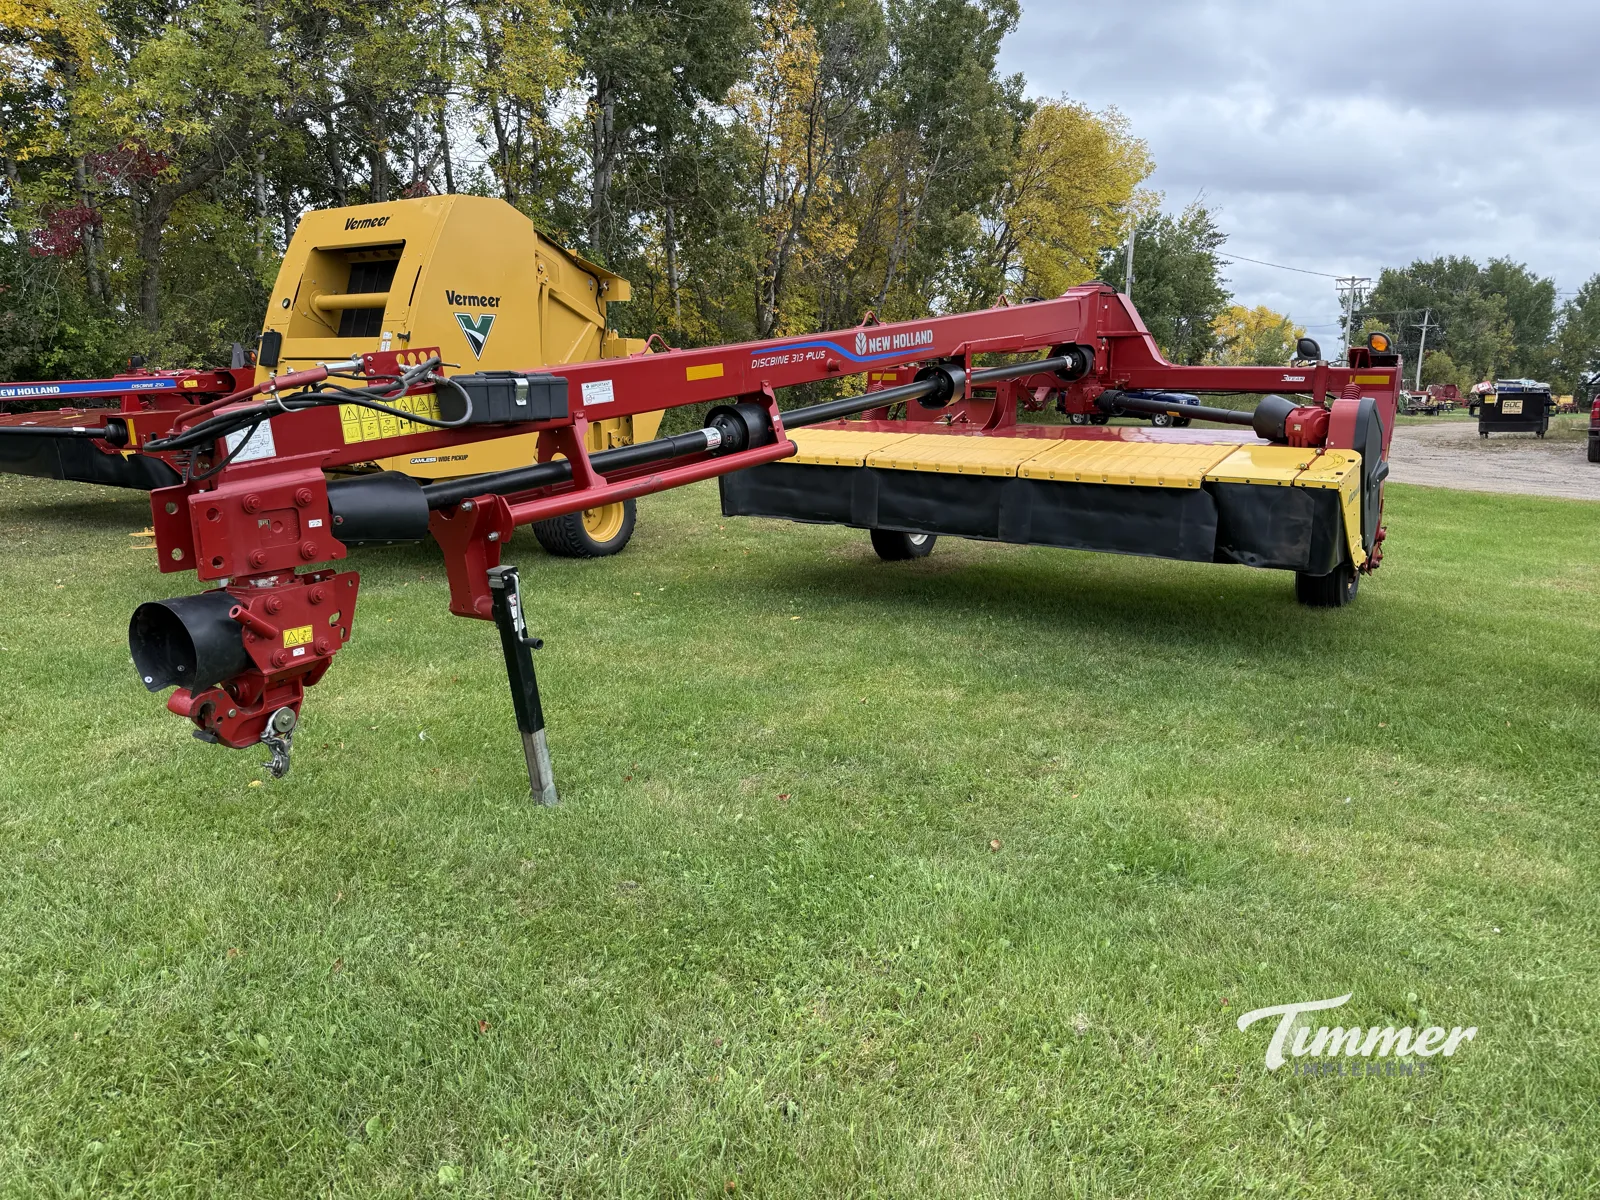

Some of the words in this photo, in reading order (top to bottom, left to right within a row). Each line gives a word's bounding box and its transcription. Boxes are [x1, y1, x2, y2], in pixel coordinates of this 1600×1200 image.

[344, 216, 391, 230] Vermeer
[445, 289, 500, 307] Vermeer
[869, 335, 891, 353] NEW
[893, 329, 933, 349] HOLLAND
[751, 354, 790, 369] DISCBINE
[791, 353, 805, 363] 313
[17, 386, 60, 395] HOLLAND
